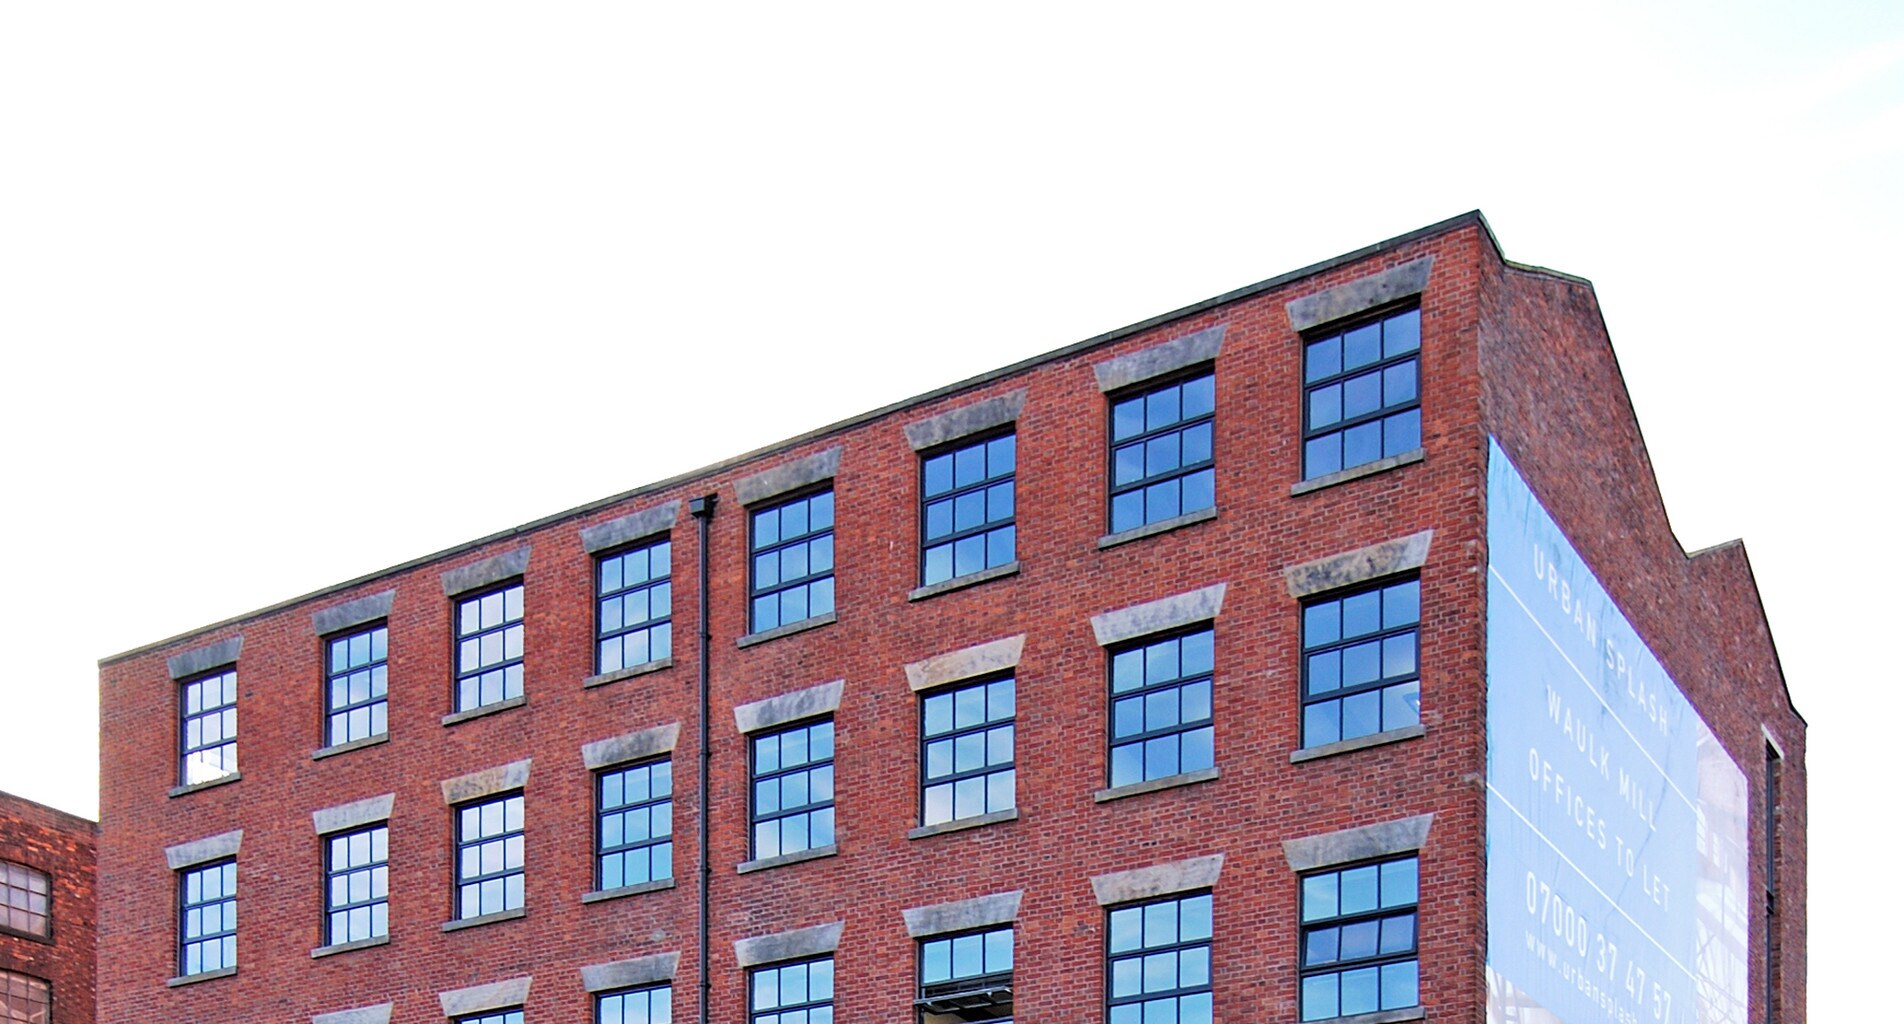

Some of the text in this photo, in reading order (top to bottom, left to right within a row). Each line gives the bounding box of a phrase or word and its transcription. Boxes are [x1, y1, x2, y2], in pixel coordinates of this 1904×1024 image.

[1533, 543, 1668, 736] URBAN SPLASH
[1528, 747, 1670, 913] OFFICES TO LET
[1547, 684, 1656, 832] WAULK MILL
[1526, 870, 1588, 957] 07000
[1596, 933, 1617, 981] 37
[1625, 960, 1645, 1005] 47
